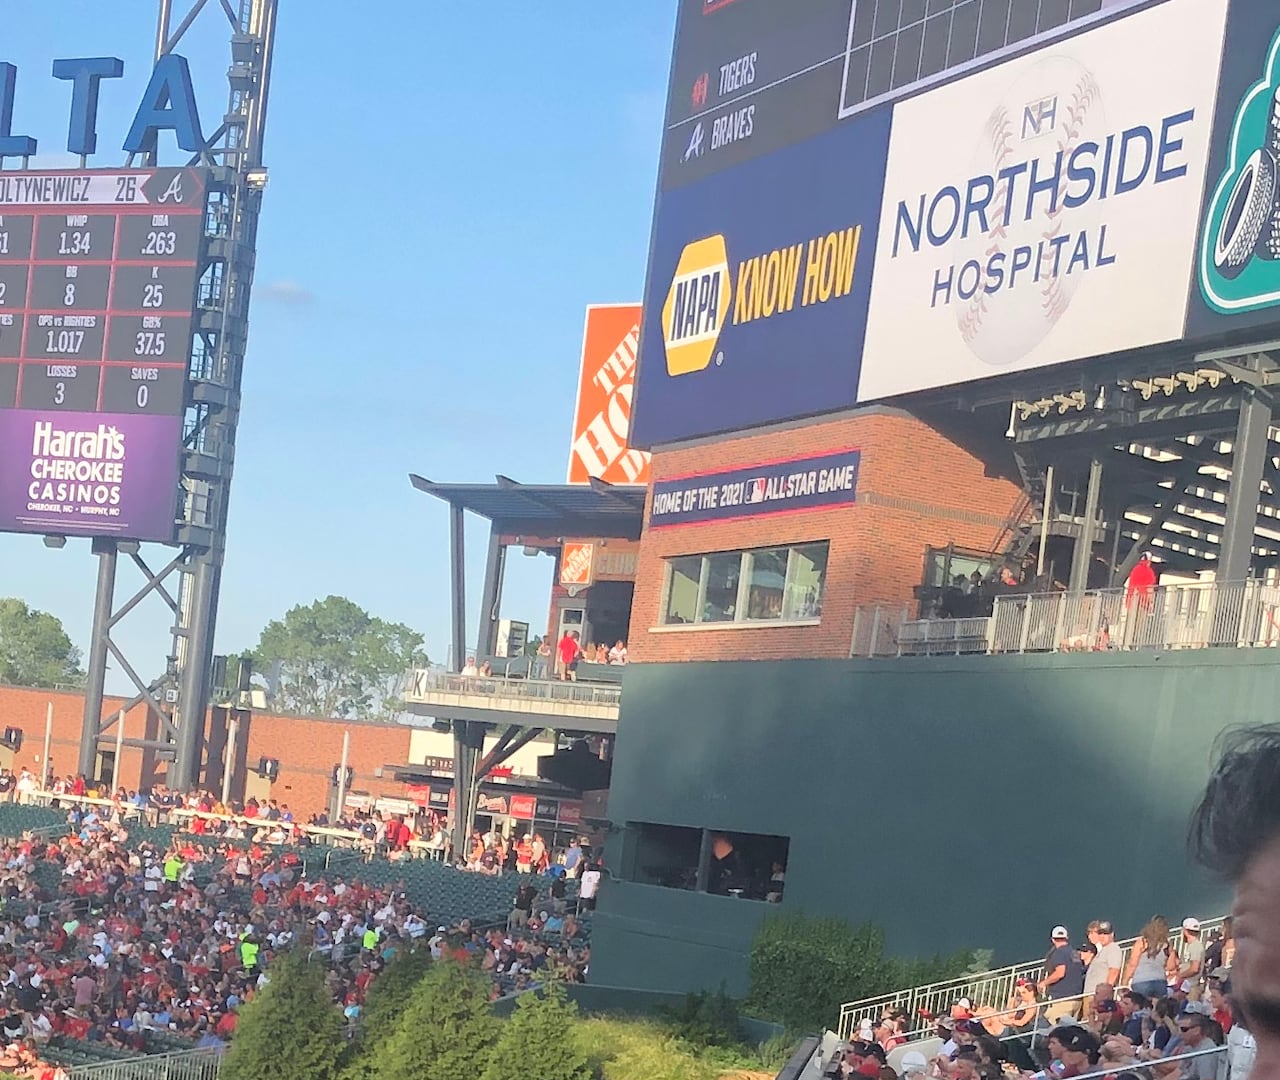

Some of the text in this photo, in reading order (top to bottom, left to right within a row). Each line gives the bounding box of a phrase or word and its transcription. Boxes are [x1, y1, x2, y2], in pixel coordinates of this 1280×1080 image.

[719, 52, 758, 96] TIGERS
[711, 105, 755, 150] BRAVES
[1021, 95, 1058, 140] NH
[115, 177, 136, 202] 26
[891, 107, 1195, 258] NORTHSIDE
[58, 231, 91, 255] 1.34
[141, 231, 176, 255] .263
[732, 224, 862, 326] KNOW HOW
[930, 224, 1117, 308] HOSPITAL
[64, 284, 75, 306] 8
[142, 285, 163, 308] 25
[671, 271, 721, 341] NAPA
[46, 331, 84, 353] 1.017
[134, 332, 165, 355] 37.5
[47, 365, 77, 378] LOSSES
[131, 367, 158, 380] SAVES
[54, 382, 65, 404] 3
[136, 384, 148, 408] 0
[573, 383, 634, 479] HO
[30, 458, 123, 483] CHEROKEE
[28, 481, 120, 505] CASINOS
[653, 489, 682, 515] HOME
[683, 489, 698, 512] OF
[698, 487, 717, 510] THE
[720, 482, 745, 508] 2021
[817, 465, 855, 493] GAME
